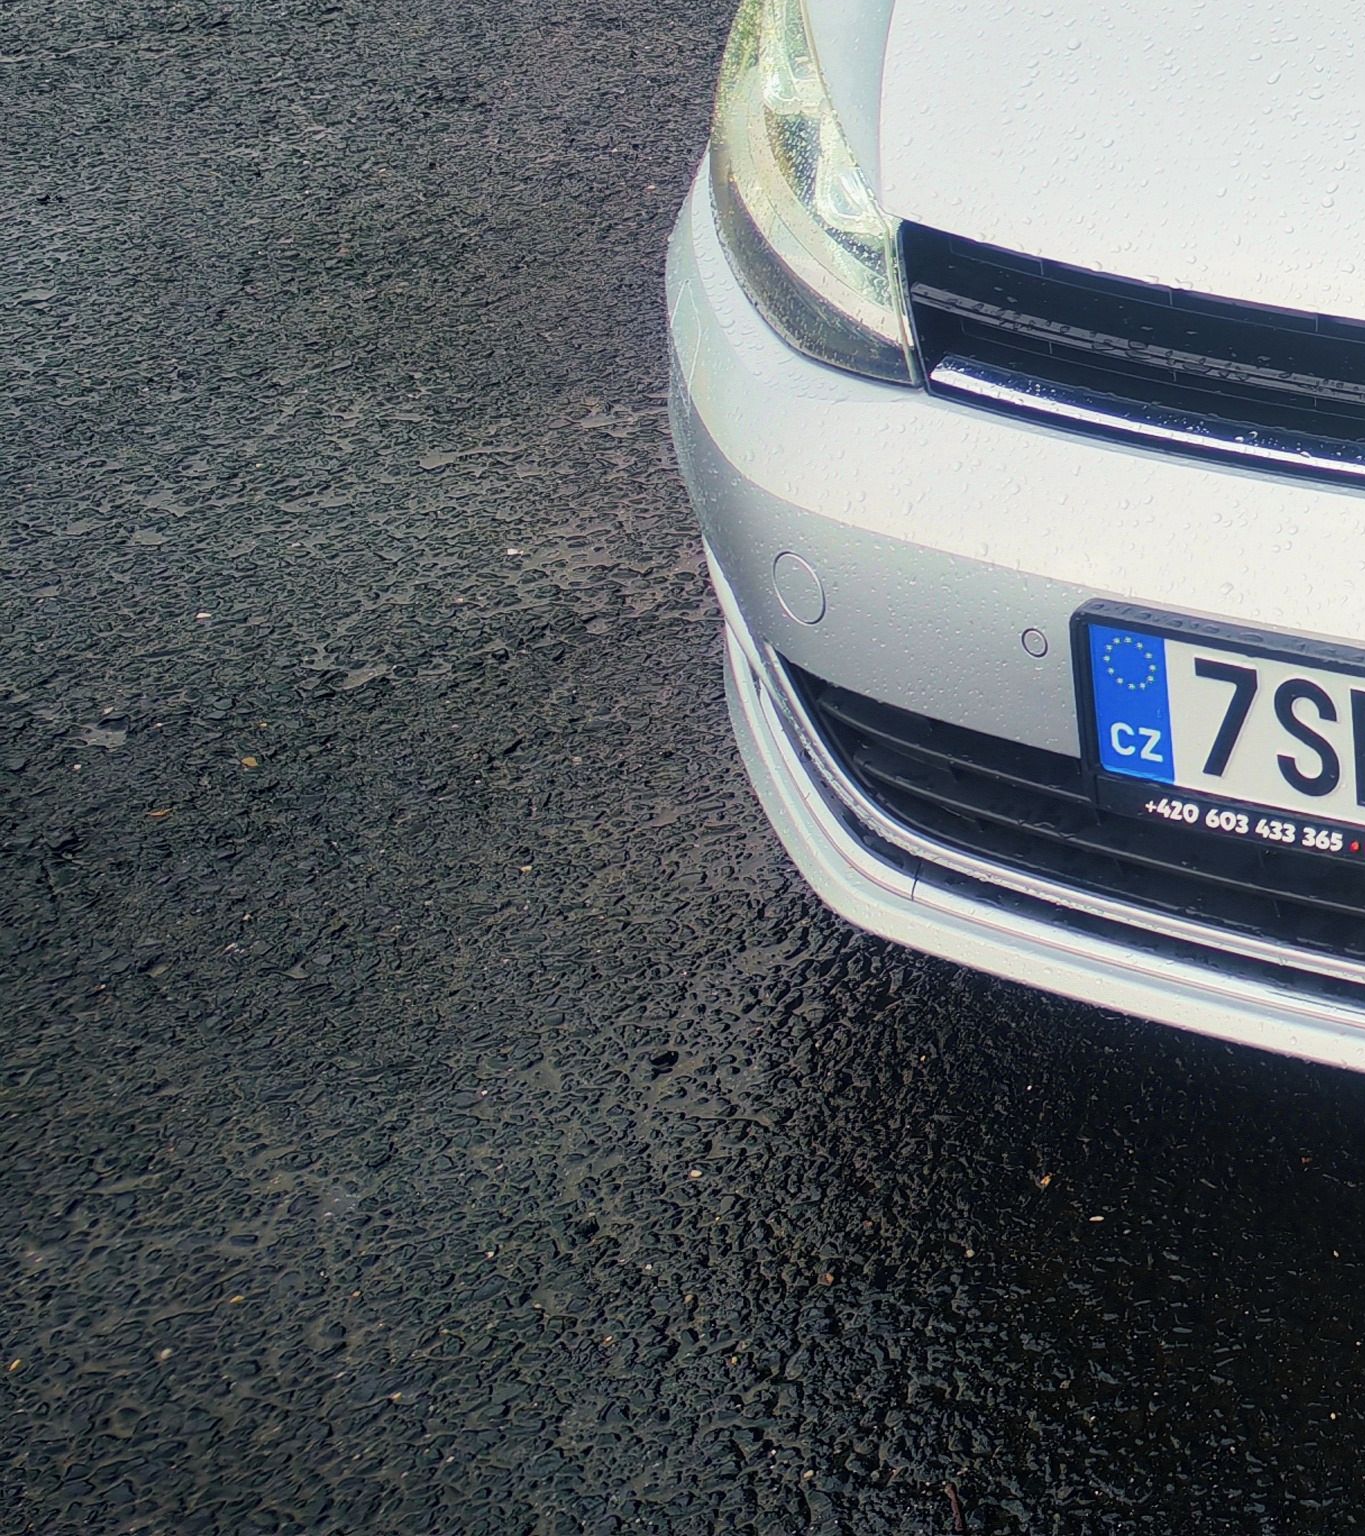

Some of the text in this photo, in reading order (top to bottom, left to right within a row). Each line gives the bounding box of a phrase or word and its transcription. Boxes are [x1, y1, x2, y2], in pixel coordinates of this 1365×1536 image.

[1110, 721, 1164, 762] CZ
[1145, 797, 1199, 824] +420
[1205, 808, 1249, 835] 603
[1255, 817, 1296, 843] 433
[1302, 826, 1343, 852] 365
